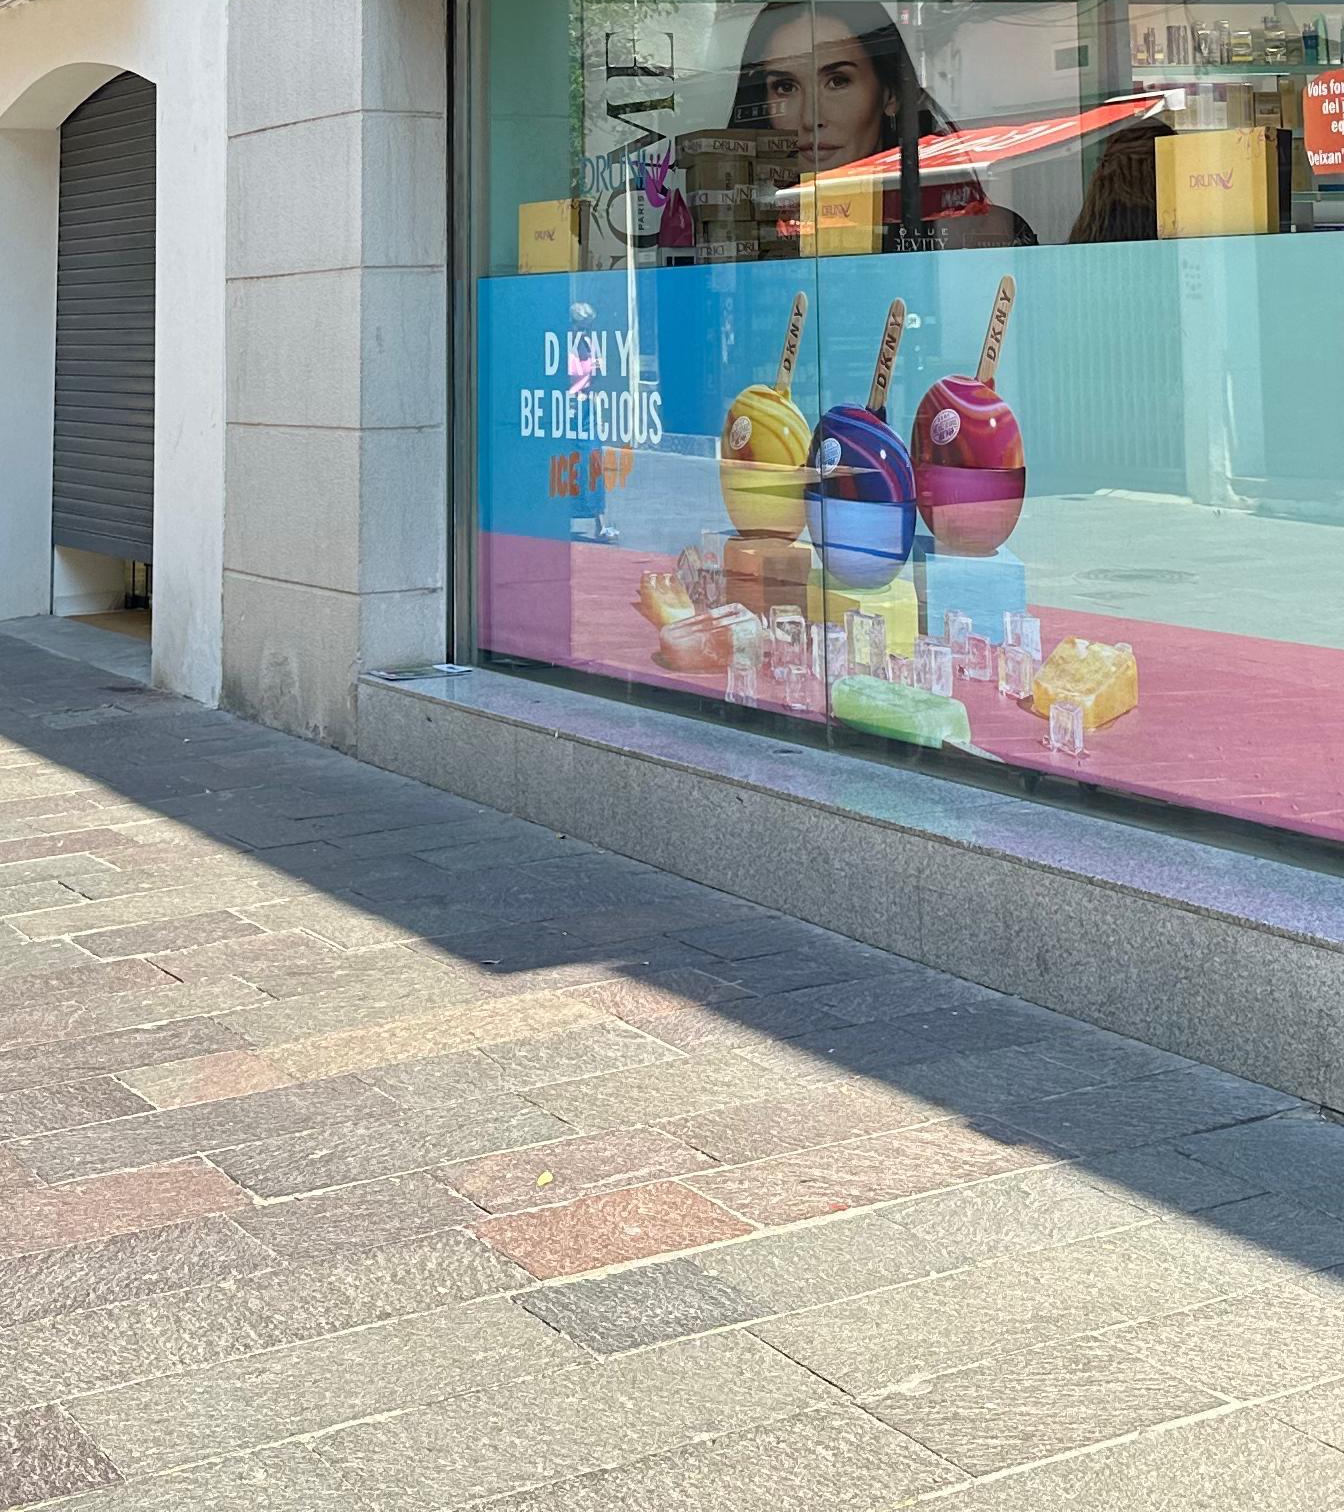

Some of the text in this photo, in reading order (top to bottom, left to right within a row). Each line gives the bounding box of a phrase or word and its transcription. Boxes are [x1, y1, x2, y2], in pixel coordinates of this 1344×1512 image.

[1307, 79, 1328, 98] Vols
[1322, 98, 1339, 115] del
[712, 139, 749, 153] DRUNI
[579, 148, 647, 194] DRUNI
[637, 195, 645, 231] PARIS
[782, 304, 805, 374] DKNY
[987, 287, 1013, 362] DKNY
[544, 330, 634, 377] DKNY
[876, 312, 905, 389] DKNY
[520, 389, 663, 445] BE DELICIOUS
[549, 450, 581, 498] ICE
